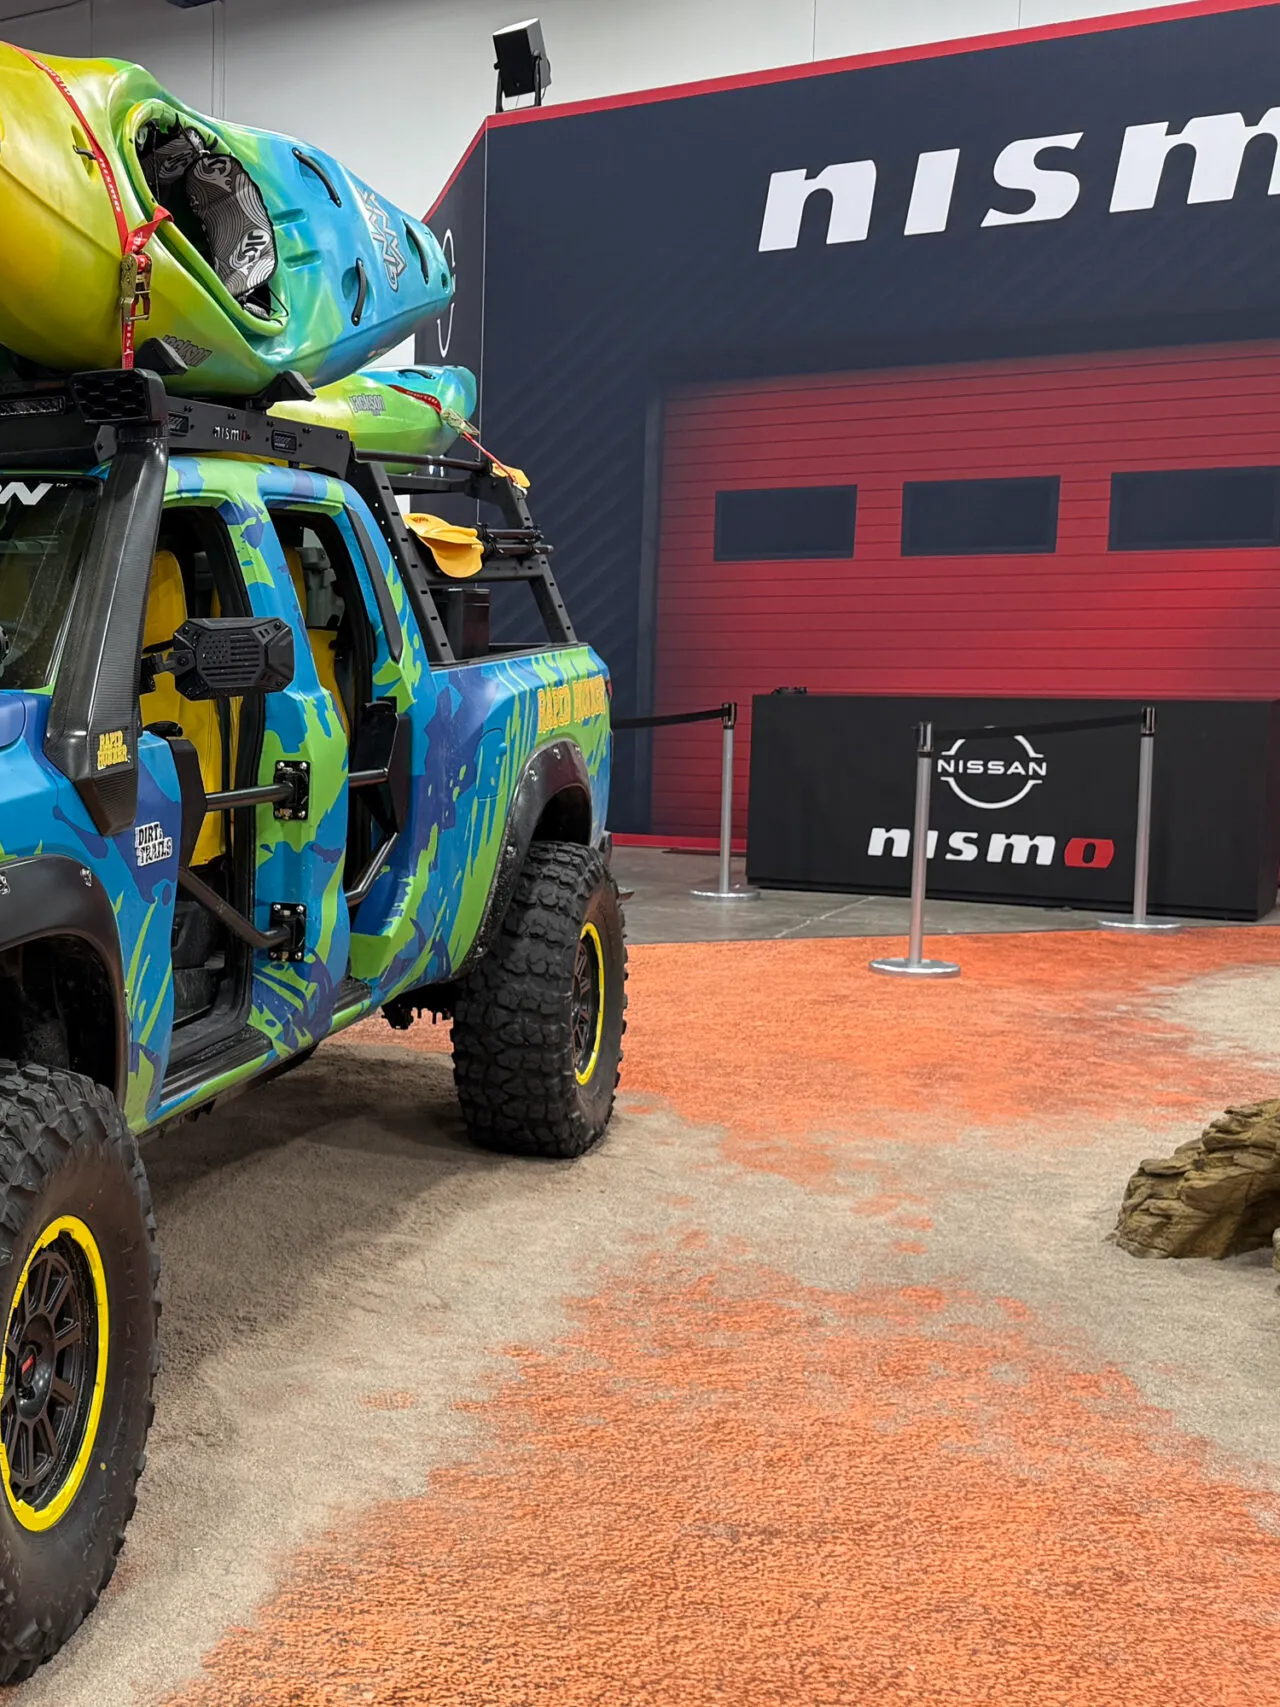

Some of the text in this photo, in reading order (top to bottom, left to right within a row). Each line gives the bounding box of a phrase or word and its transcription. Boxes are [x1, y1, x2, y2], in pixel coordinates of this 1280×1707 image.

[214, 426, 250, 442] nismo
[936, 758, 1048, 777] NISSAN
[138, 823, 160, 845] DIRT
[139, 838, 172, 865] TRAILS
